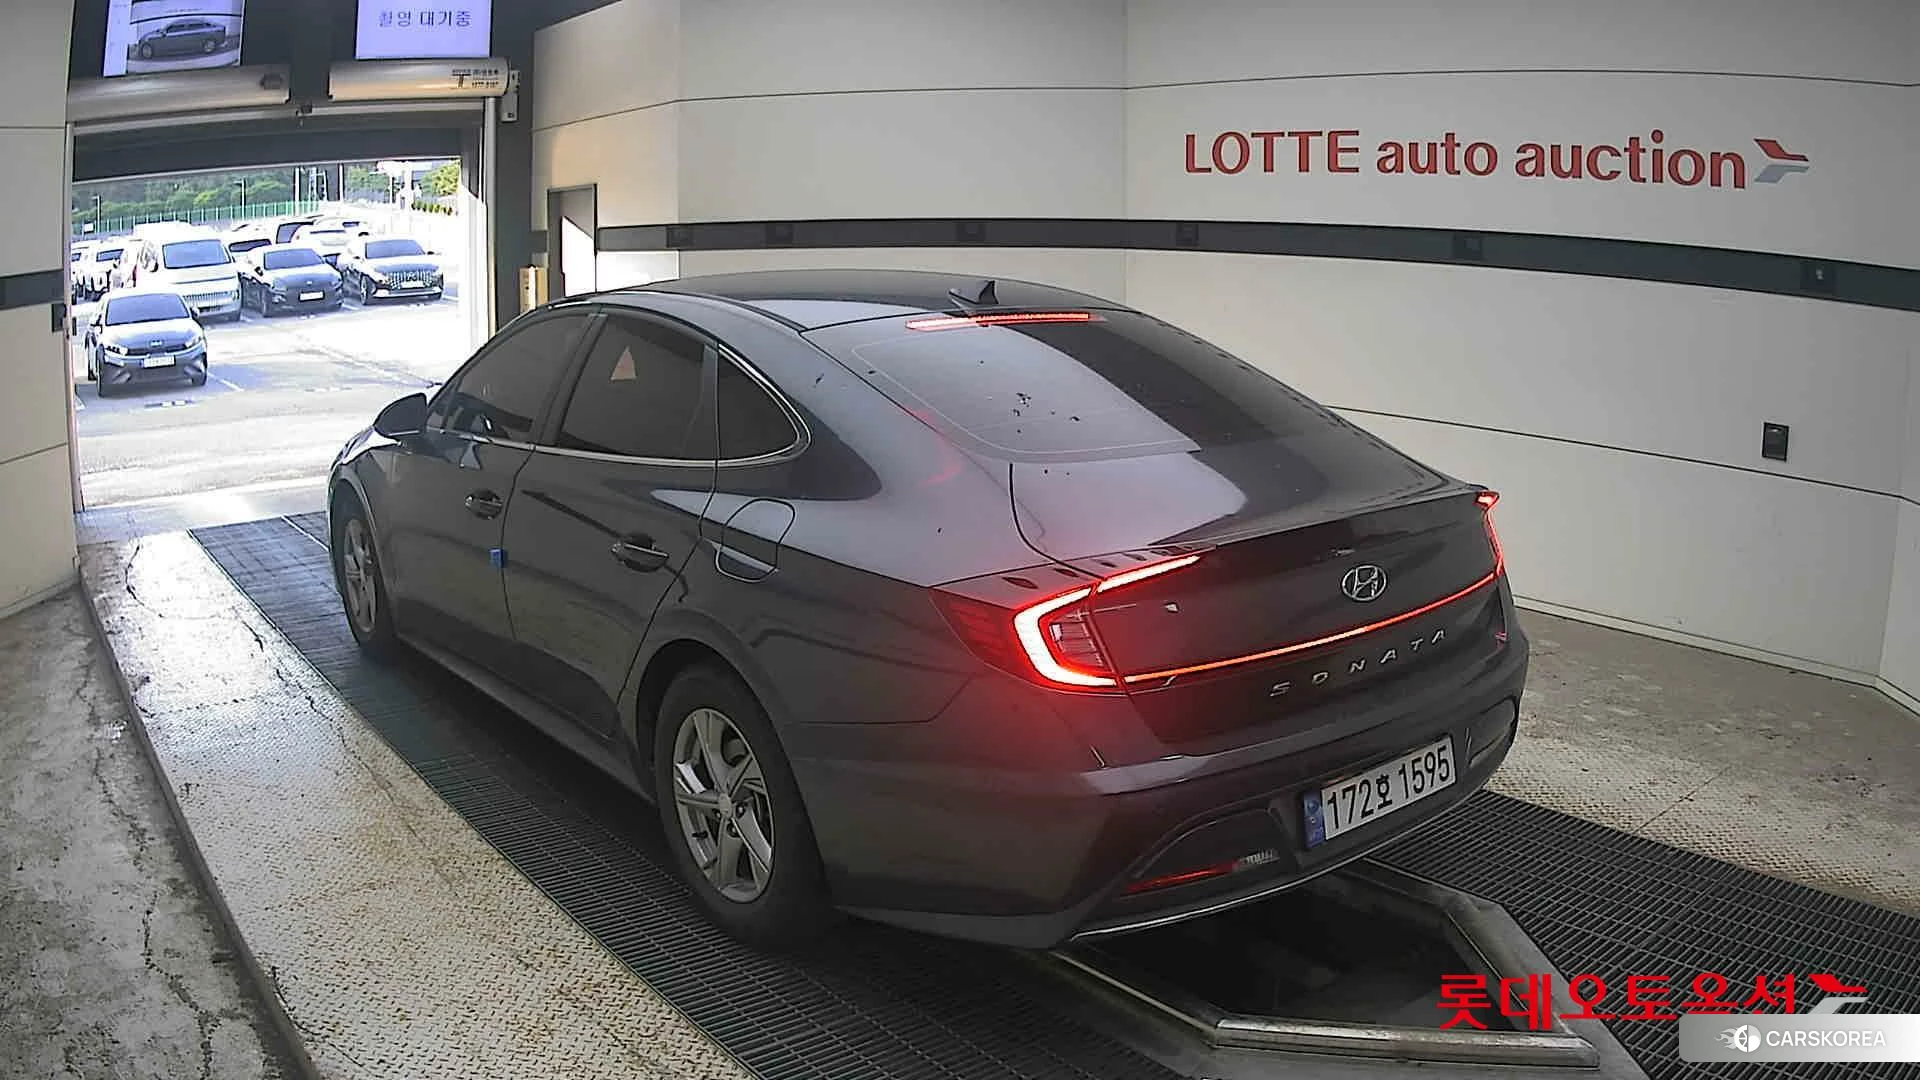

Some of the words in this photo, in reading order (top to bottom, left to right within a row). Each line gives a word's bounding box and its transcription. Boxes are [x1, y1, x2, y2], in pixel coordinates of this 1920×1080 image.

[419, 10, 472, 28] 대기중
[1185, 130, 1360, 174] LOTTE
[1376, 132, 1499, 176] auto
[1514, 130, 1745, 189] auction
[1269, 629, 1447, 697] SONATA
[1327, 774, 1393, 830] 172호
[1398, 744, 1450, 800] 1595
